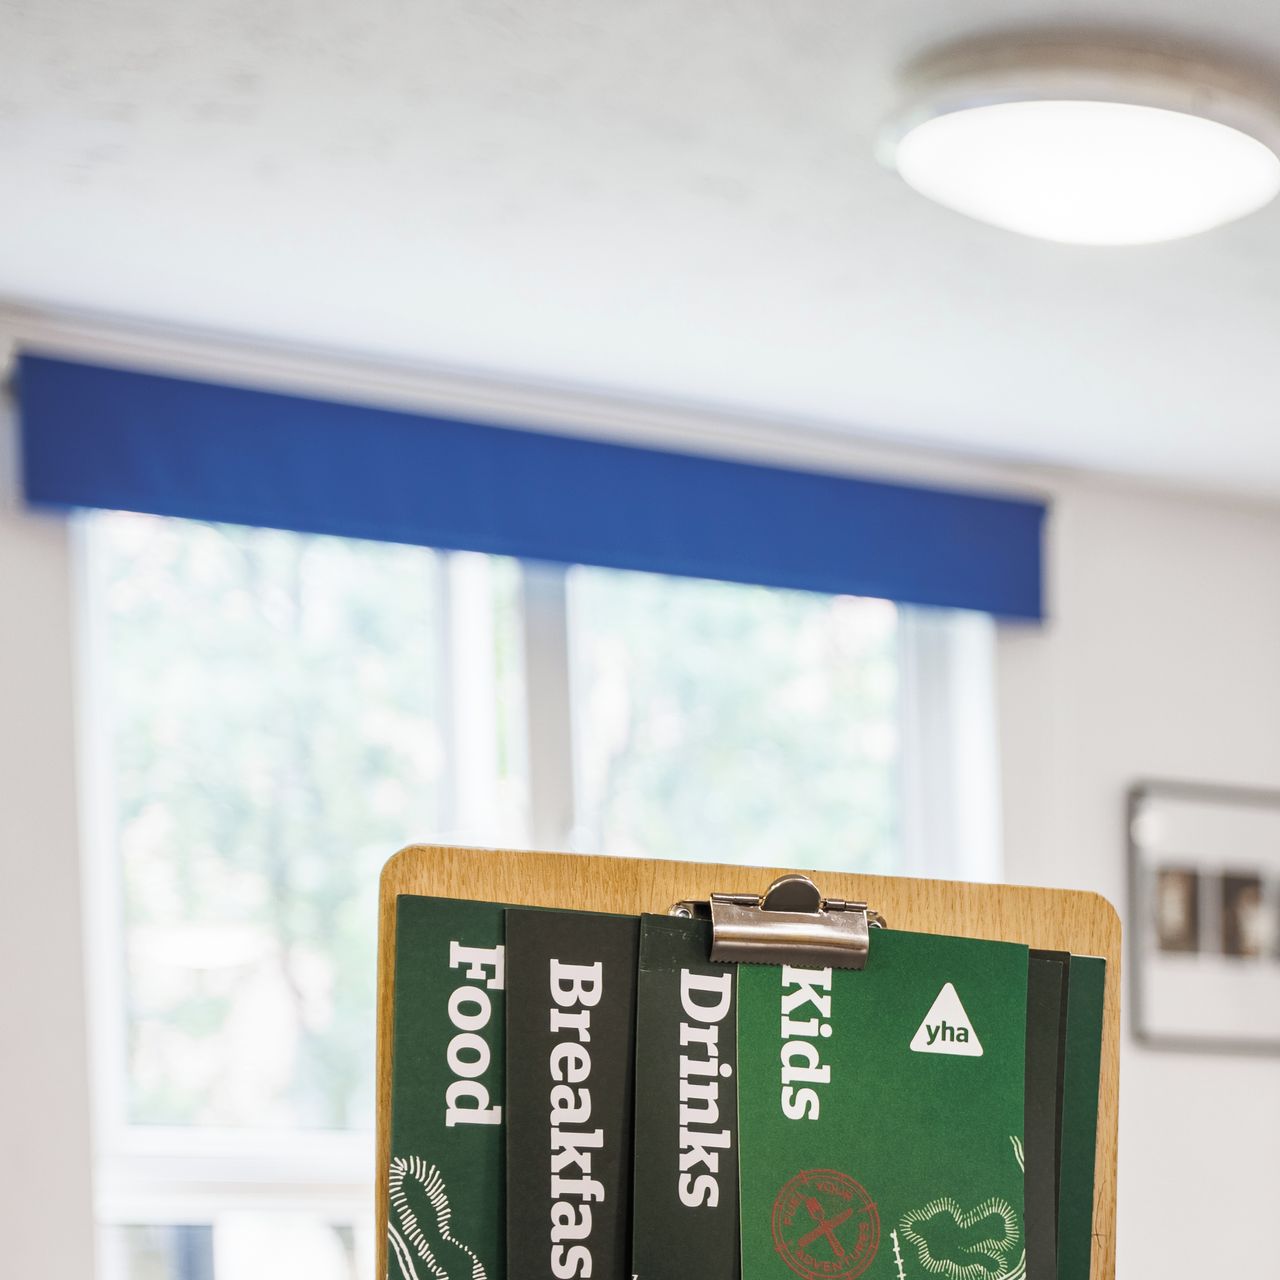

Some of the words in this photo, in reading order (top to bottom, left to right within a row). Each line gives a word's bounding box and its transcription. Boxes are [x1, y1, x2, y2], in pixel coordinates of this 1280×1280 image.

[446, 941, 505, 1127] Food
[678, 968, 733, 1208] Drinks
[780, 964, 833, 1121] Kids
[926, 1020, 969, 1046] yha
